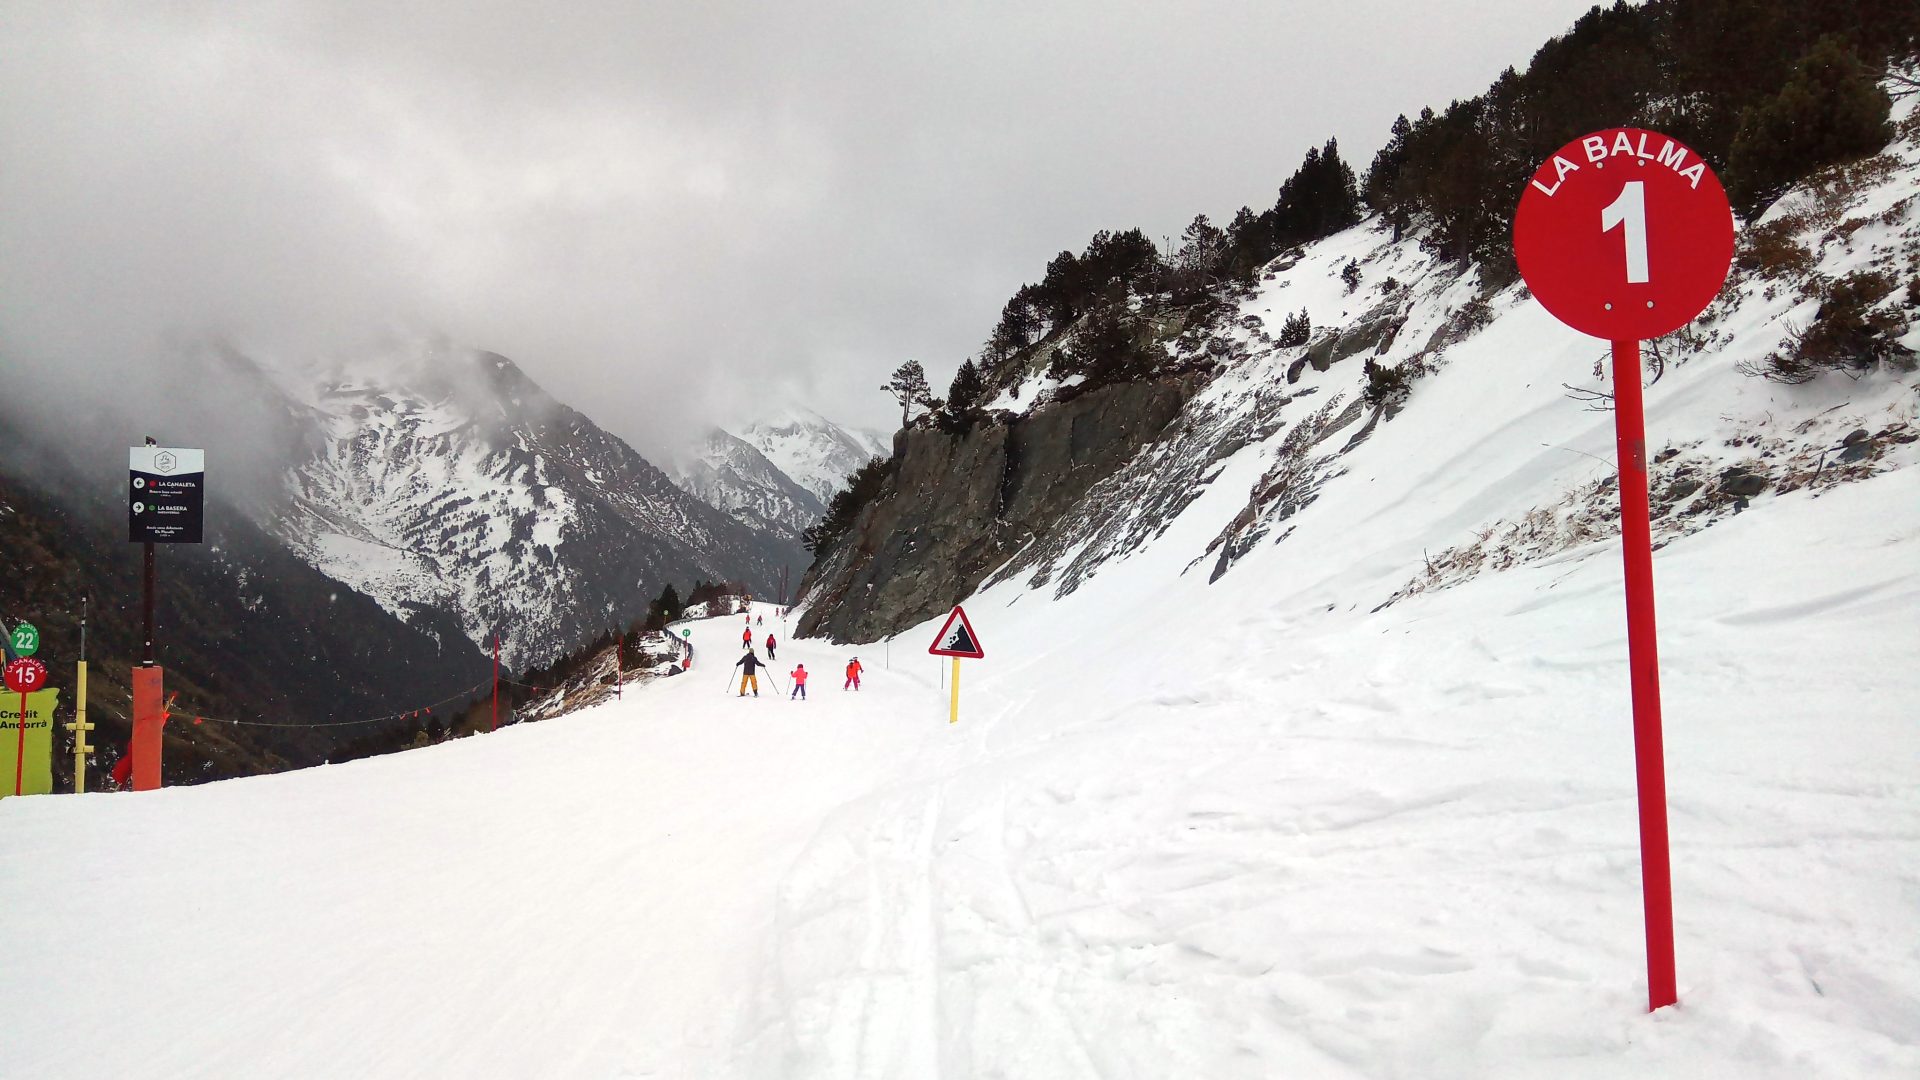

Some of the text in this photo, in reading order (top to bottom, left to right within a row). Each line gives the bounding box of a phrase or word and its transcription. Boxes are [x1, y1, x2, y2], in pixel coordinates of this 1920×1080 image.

[1532, 131, 1705, 197] LA BALMA
[1601, 180, 1649, 284] 1
[15, 632, 34, 649] 22
[6, 658, 45, 674] LA CANALETA
[15, 666, 35, 684] 15
